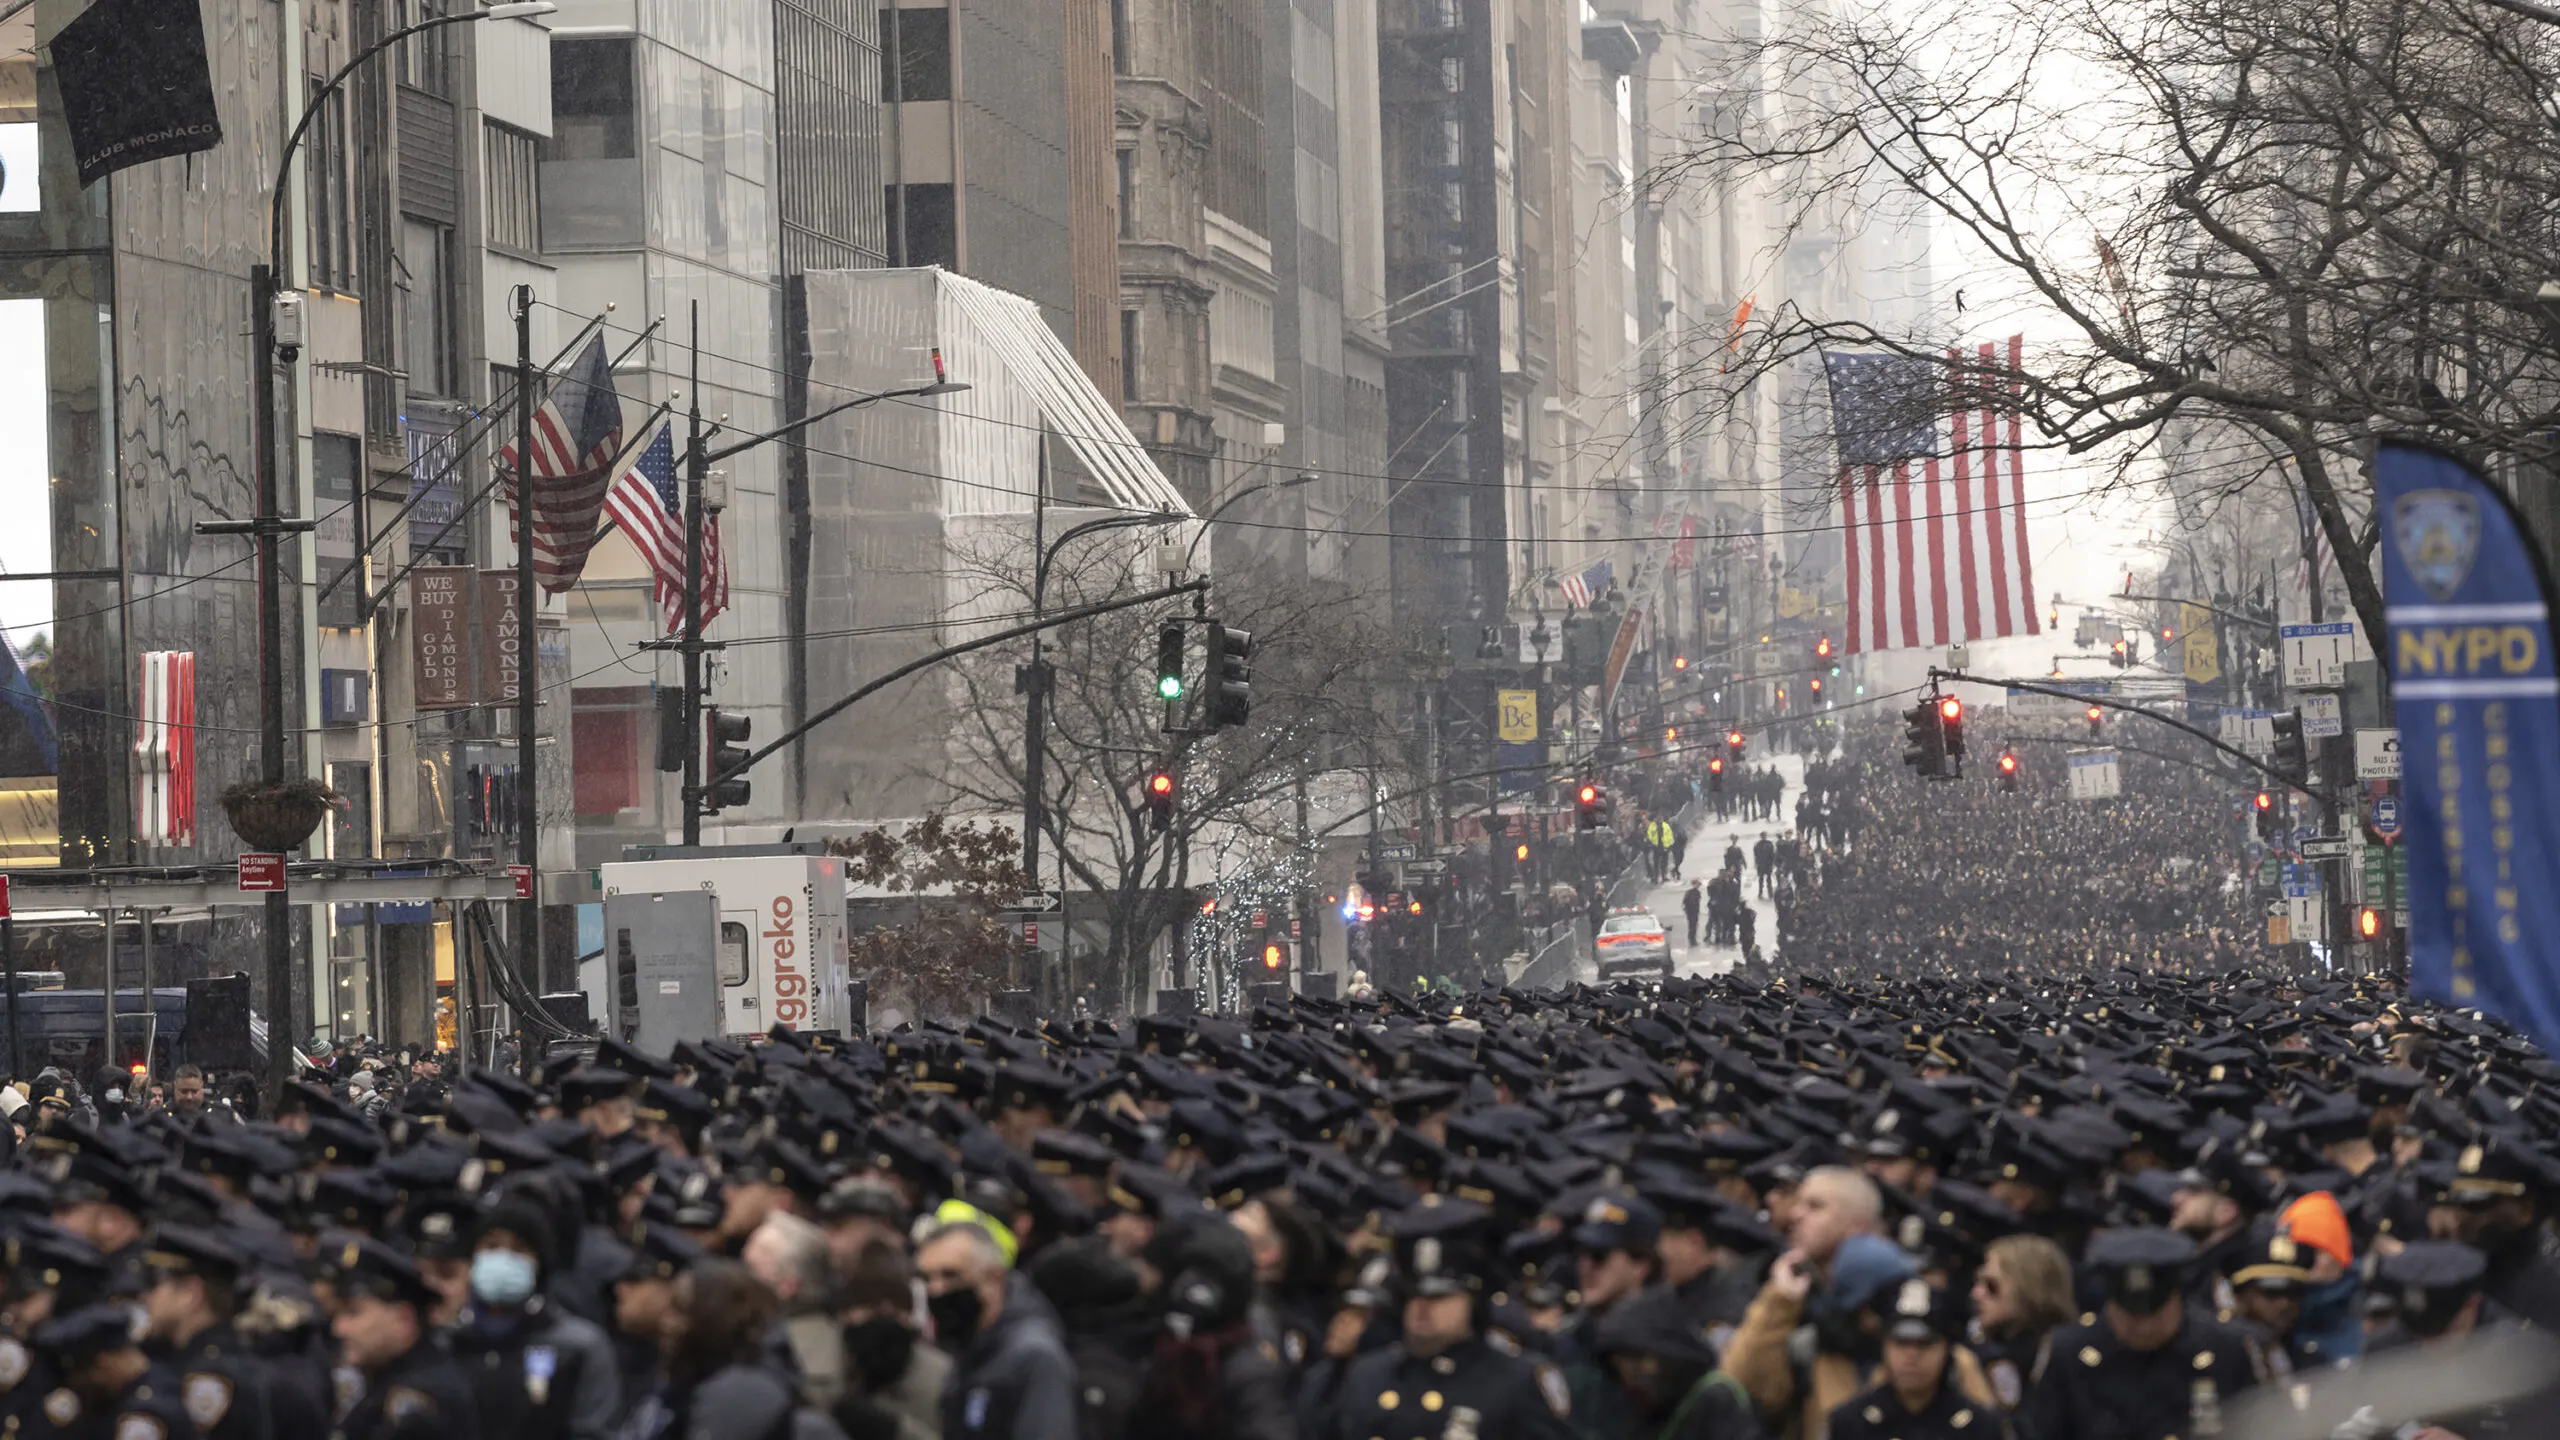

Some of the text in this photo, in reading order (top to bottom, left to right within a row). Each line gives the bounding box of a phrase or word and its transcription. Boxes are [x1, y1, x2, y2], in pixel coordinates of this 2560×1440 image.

[84, 124, 214, 169] CLUB MONACO
[423, 577, 453, 590] WE
[420, 591, 457, 605] BUY
[2299, 626, 2312, 635] BUS
[497, 578, 519, 699] DIAMONDS
[423, 633, 438, 678] GOLD
[441, 609, 457, 700] DIAMONDS
[2398, 626, 2539, 675] NYPD
[2308, 698, 2333, 707] NYPD
[1503, 705, 1533, 728] Be
[2303, 718, 2339, 726] SECURITY
[2305, 726, 2339, 735] CAMERA
[2374, 756, 2388, 764] BUS
[2362, 767, 2386, 775] PHOTO
[2306, 843, 2350, 854] ONE WA
[241, 857, 278, 865] NO STANDING
[242, 866, 265, 874] Anytime
[1032, 898, 1052, 907] WAY
[763, 896, 808, 1031] ggreko
